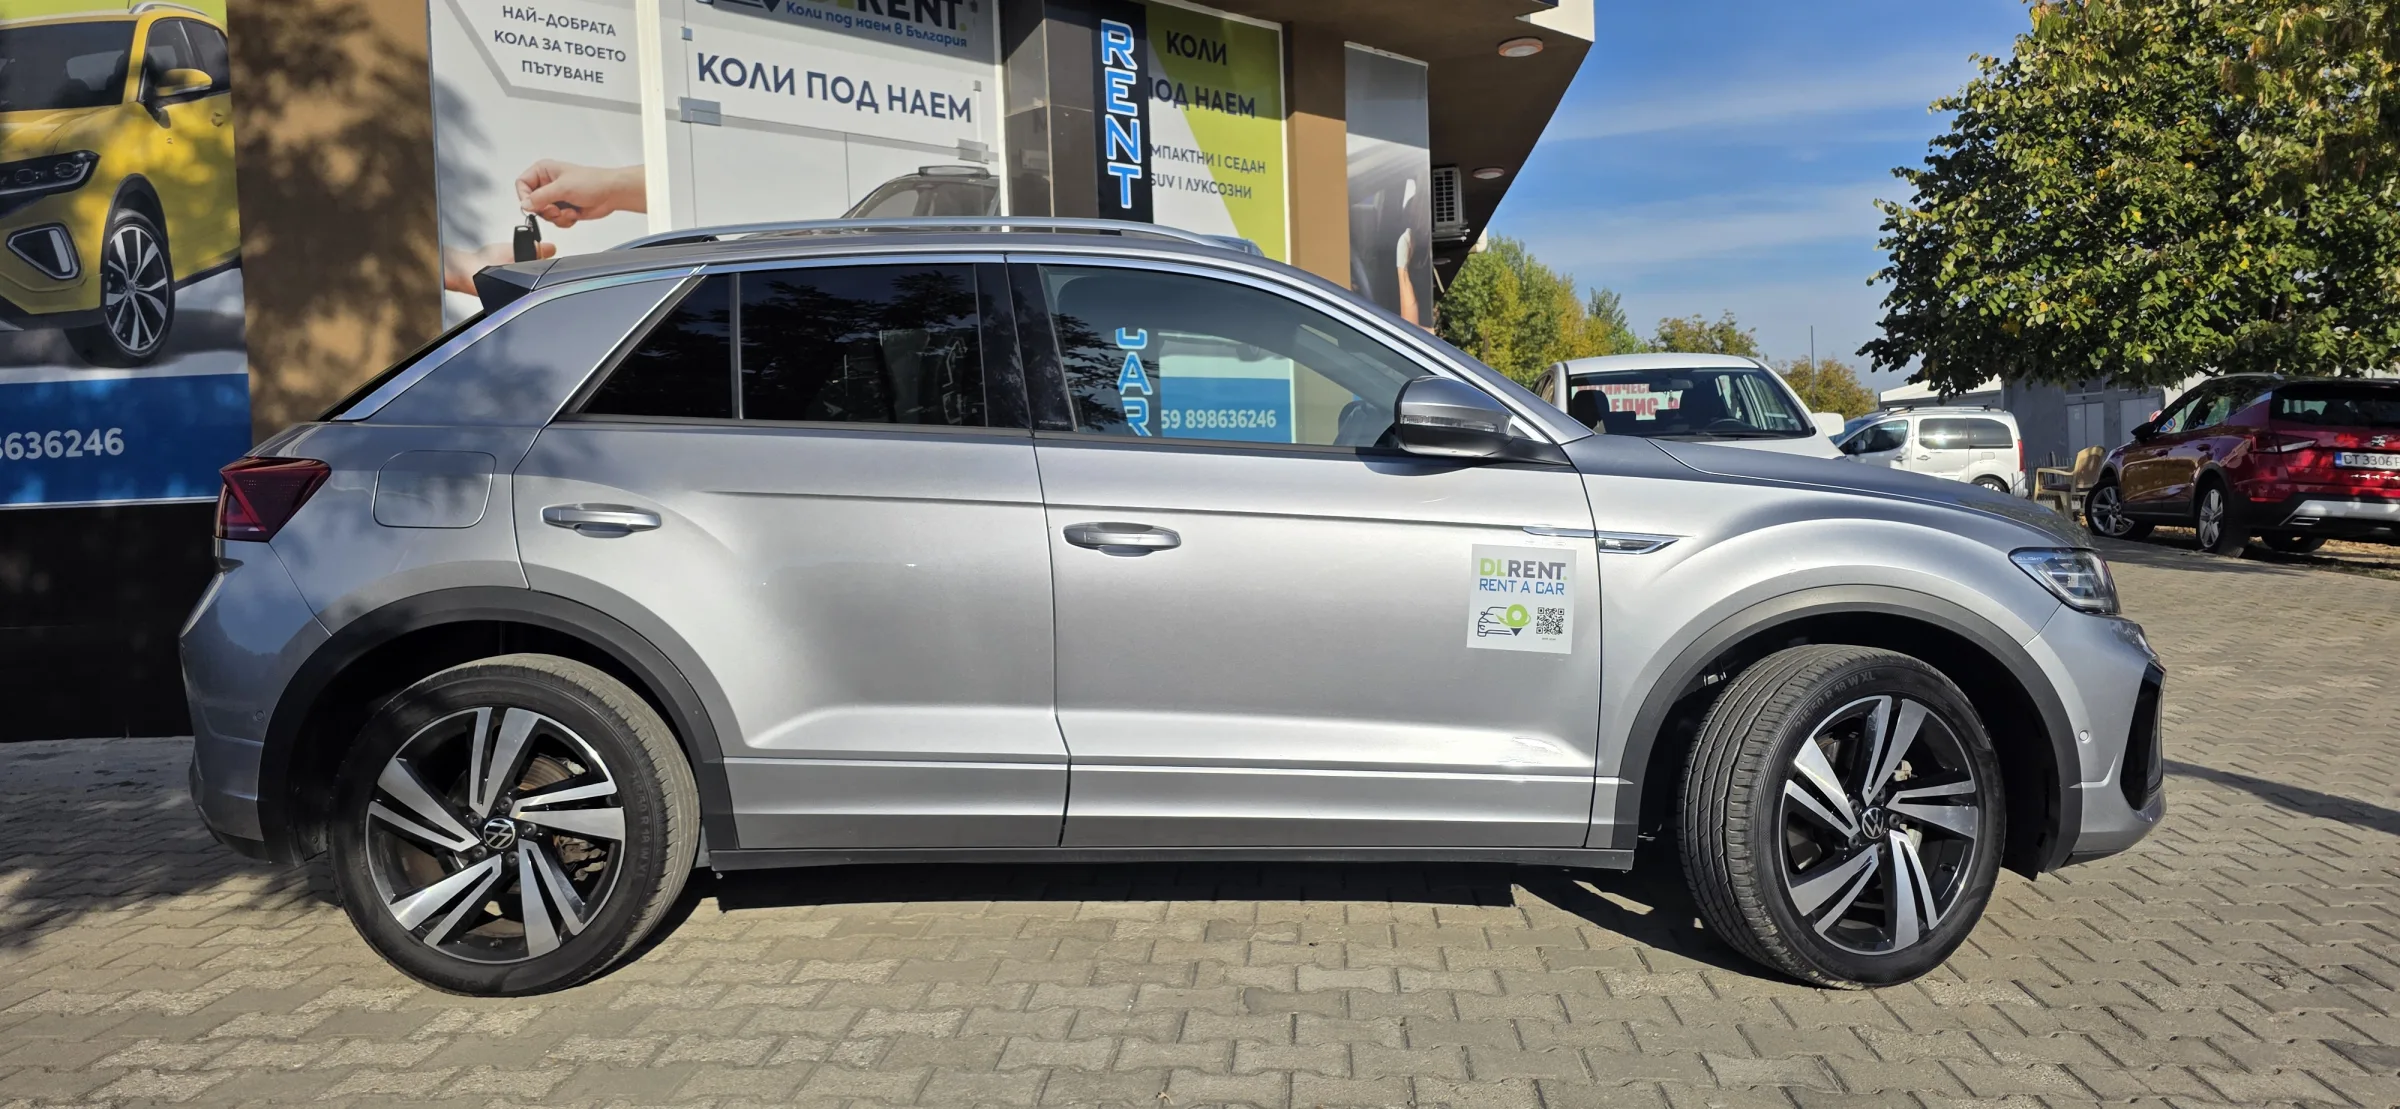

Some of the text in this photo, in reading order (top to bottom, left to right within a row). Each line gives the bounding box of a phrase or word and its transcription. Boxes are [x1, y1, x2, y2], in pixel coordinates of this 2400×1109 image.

[502, 5, 616, 36] НАЙ-ДОБРАТА
[786, 1, 967, 48] Коли под наем в България
[494, 30, 626, 62] КОЛА ЗА ТВОЕТО
[1166, 30, 1227, 66] КОЛИ
[521, 60, 604, 84] ПЪТУВАНЕ
[697, 52, 972, 123] КОЛИ ПОД НАЕМ
[1101, 19, 1142, 209] RENT
[1195, 85, 1255, 119] НАЕМ
[1224, 156, 1266, 174] СЕДАН
[1150, 173, 1175, 189] SUV
[1185, 178, 1252, 199] ЛУКСОЗНИ
[1185, 409, 1277, 429] 898636246
[0, 427, 125, 460] 636246
[2343, 454, 2360, 465] CT
[2362, 455, 2393, 466] 3306
[1479, 557, 1567, 580] DLRENT.
[1479, 578, 1565, 595] RENT A CAR
[1861, 671, 1876, 683] XL
